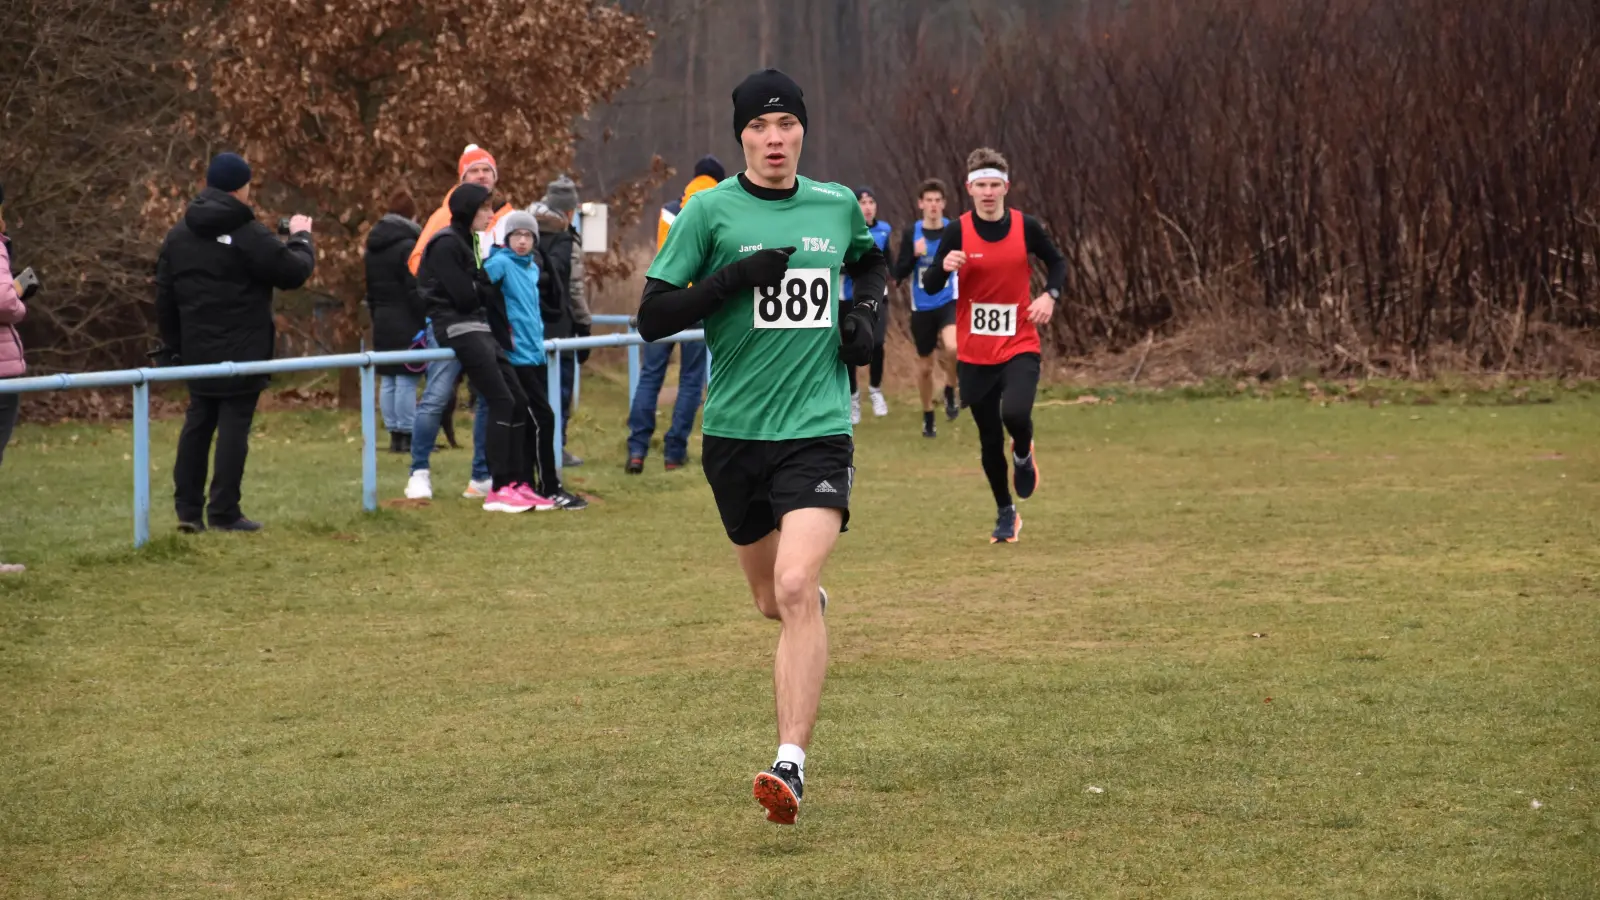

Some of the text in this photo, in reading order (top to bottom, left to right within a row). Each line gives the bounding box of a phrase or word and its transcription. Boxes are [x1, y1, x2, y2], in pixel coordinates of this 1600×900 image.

[738, 242, 763, 253] Jared
[801, 236, 830, 252] TSV
[973, 307, 1010, 332] 881
